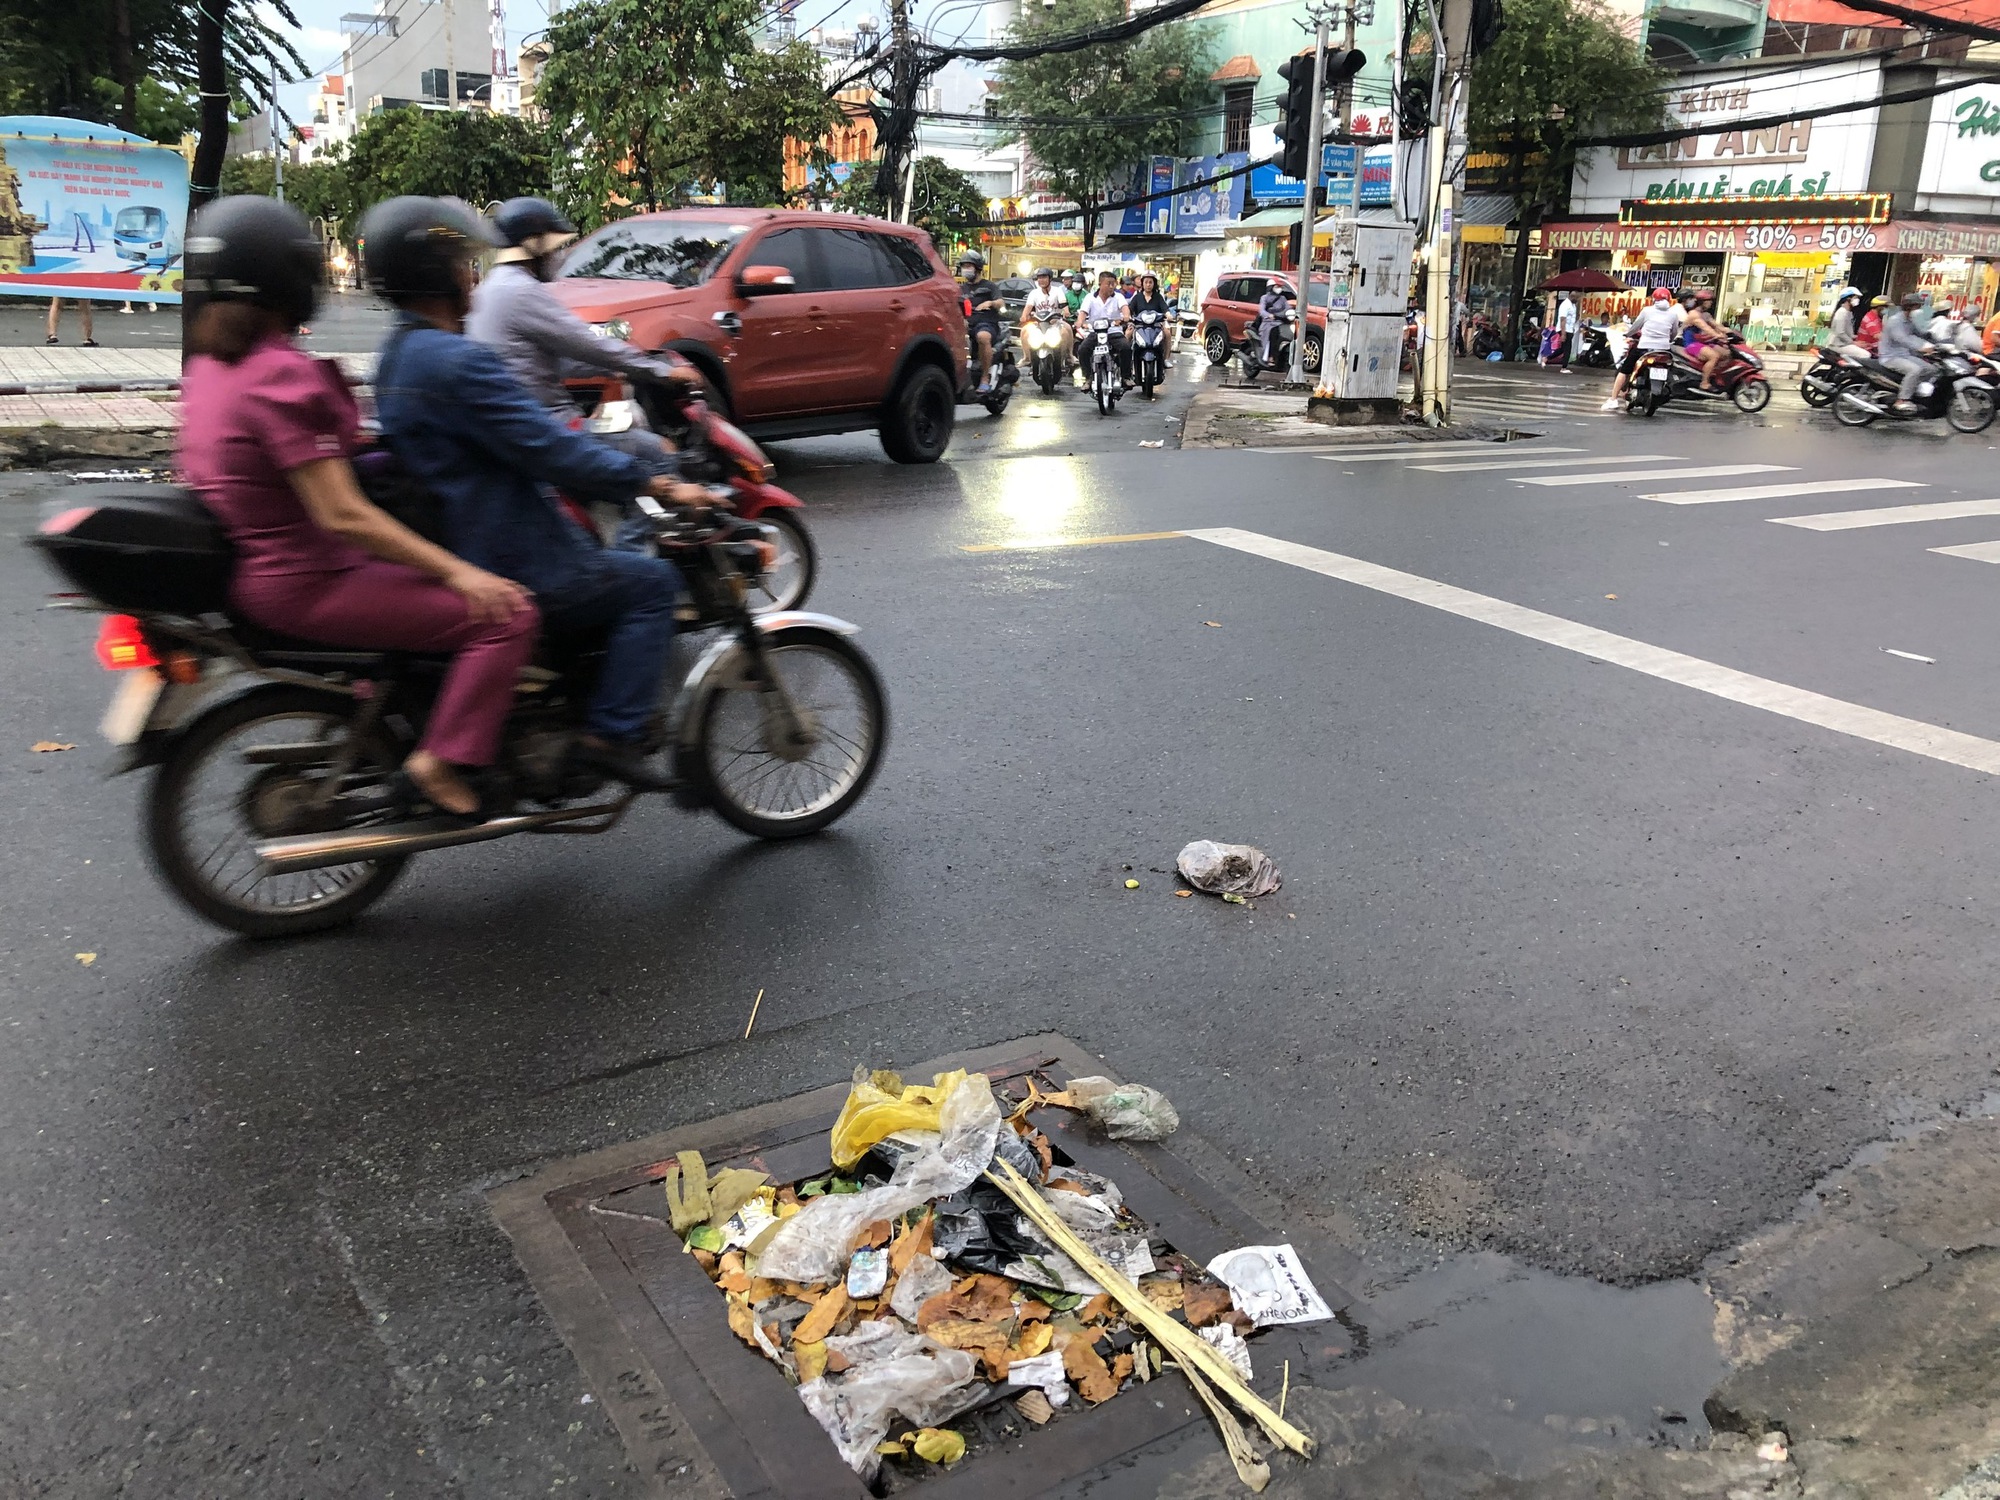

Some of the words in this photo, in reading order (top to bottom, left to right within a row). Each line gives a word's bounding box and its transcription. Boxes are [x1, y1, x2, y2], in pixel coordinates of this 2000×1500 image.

[1679, 84, 1751, 113] KÍNH
[1714, 117, 1812, 156] ANH
[1646, 178, 1695, 200] BÁN
[1700, 174, 1730, 197] LẺ
[1749, 174, 1795, 197] GIÁ
[1801, 171, 1830, 197] SỈ
[1549, 223, 1614, 248] KHUYẾN
[1617, 228, 1650, 249] MÃI
[1705, 226, 1736, 249] GIÁ
[1744, 226, 1797, 250] 30%
[1818, 225, 1877, 249] 50%
[1897, 224, 1956, 251] KHUYẾN
